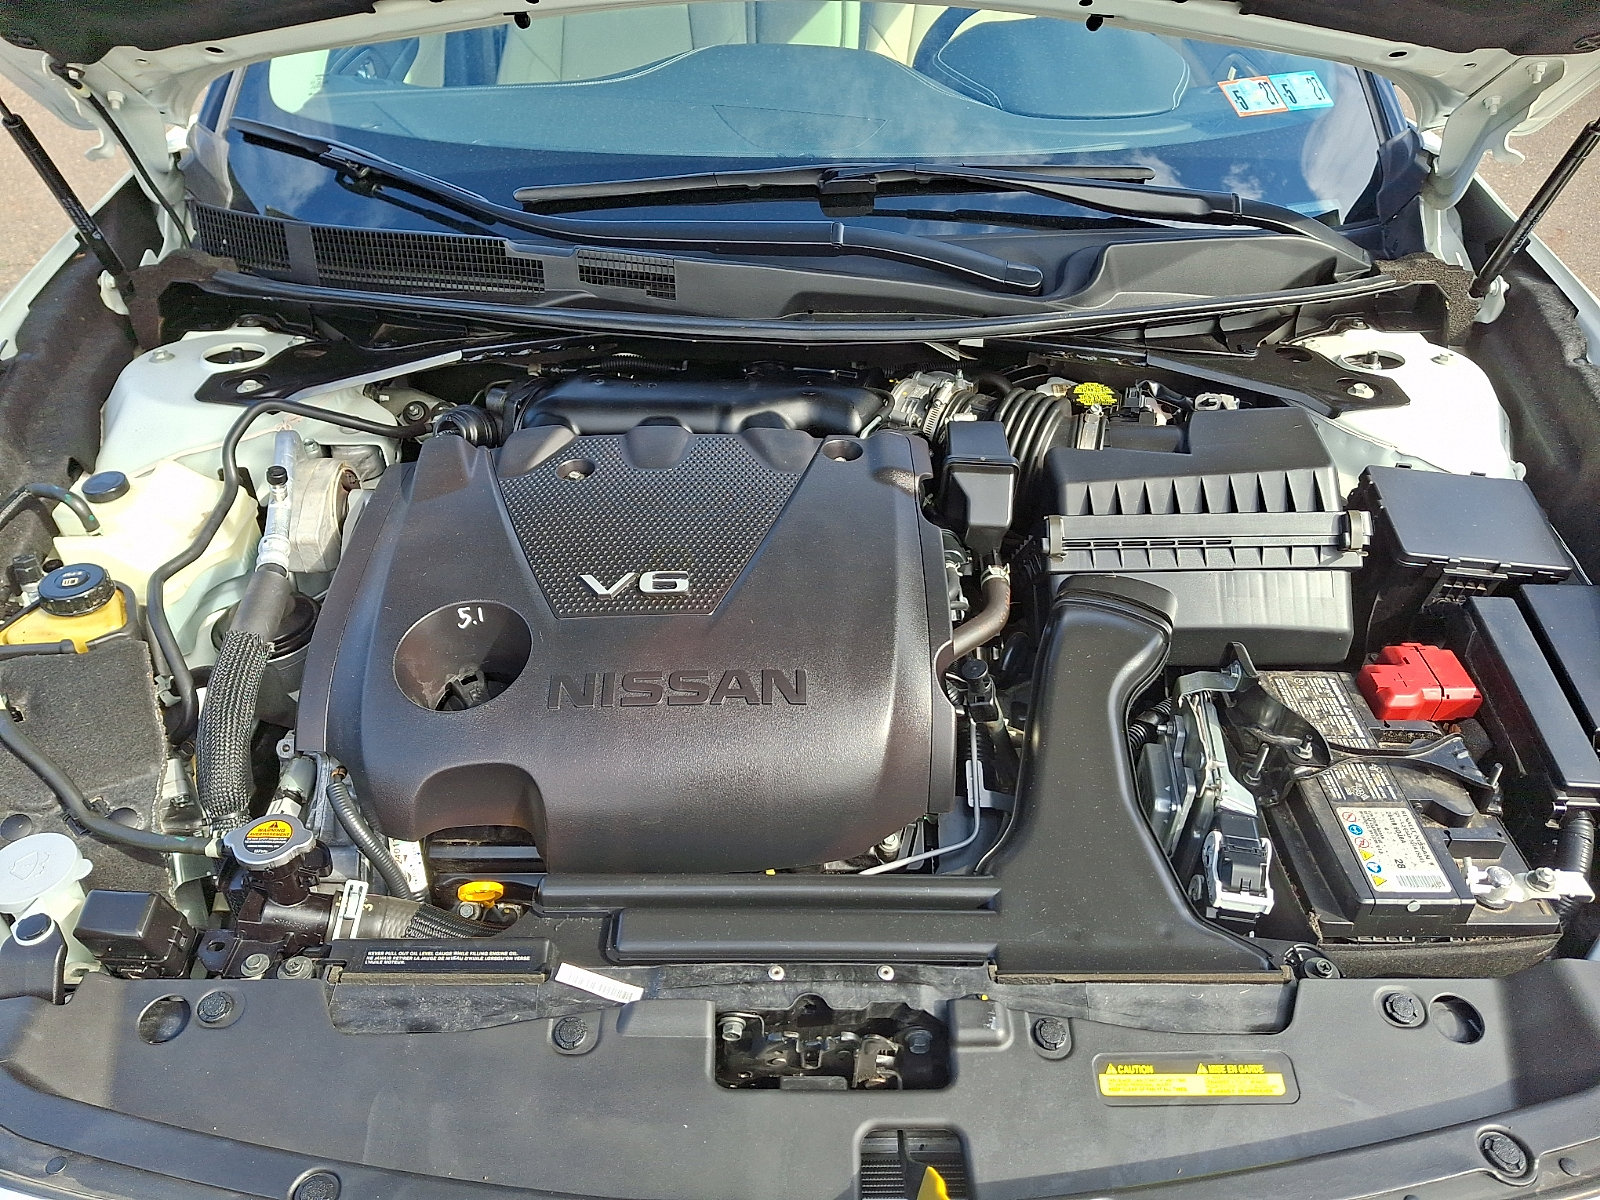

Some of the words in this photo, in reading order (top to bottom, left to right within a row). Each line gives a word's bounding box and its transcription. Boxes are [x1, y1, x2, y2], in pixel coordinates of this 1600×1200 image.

[1232, 90, 1249, 110] 5
[1281, 83, 1298, 104] 5
[579, 570, 690, 599] V6
[457, 606, 484, 629] 5.1
[548, 669, 808, 708] NISSAN
[1393, 858, 1406, 868] 28
[1117, 1065, 1154, 1074] CAUTION
[1227, 1064, 1238, 1073] EN
[1238, 1064, 1265, 1073] GARDE
